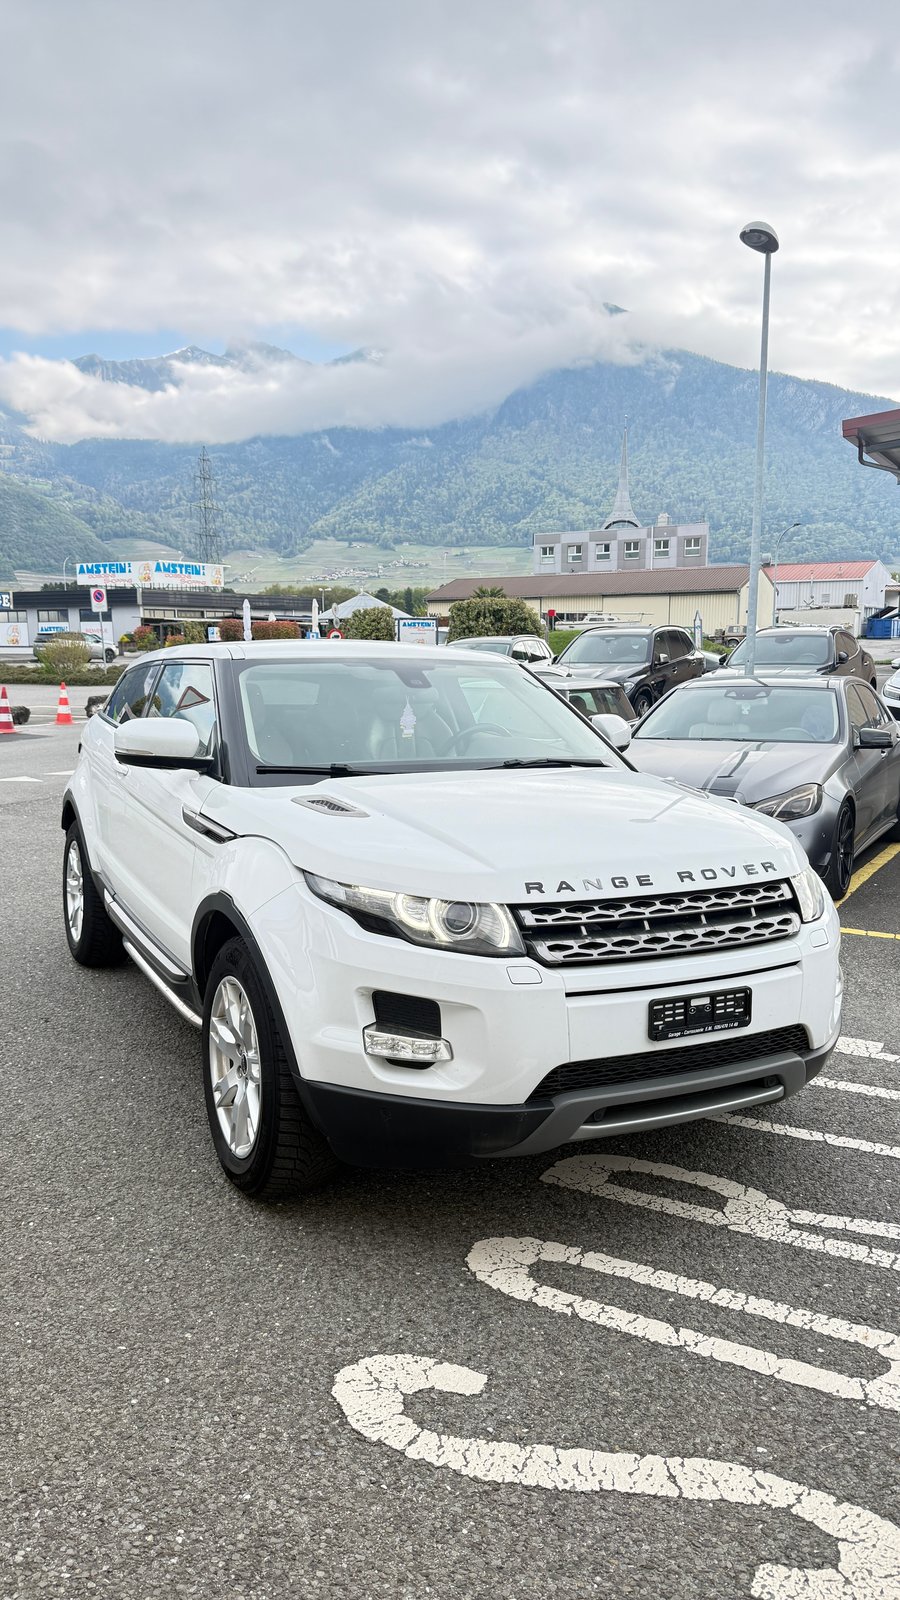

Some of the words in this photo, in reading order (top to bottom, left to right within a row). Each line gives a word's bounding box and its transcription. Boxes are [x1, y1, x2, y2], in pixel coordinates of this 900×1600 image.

[79, 563, 126, 574] AMSTEIN
[155, 562, 201, 575] AMSTEIN
[524, 874, 654, 895] RANGE
[677, 861, 778, 883] ROVER
